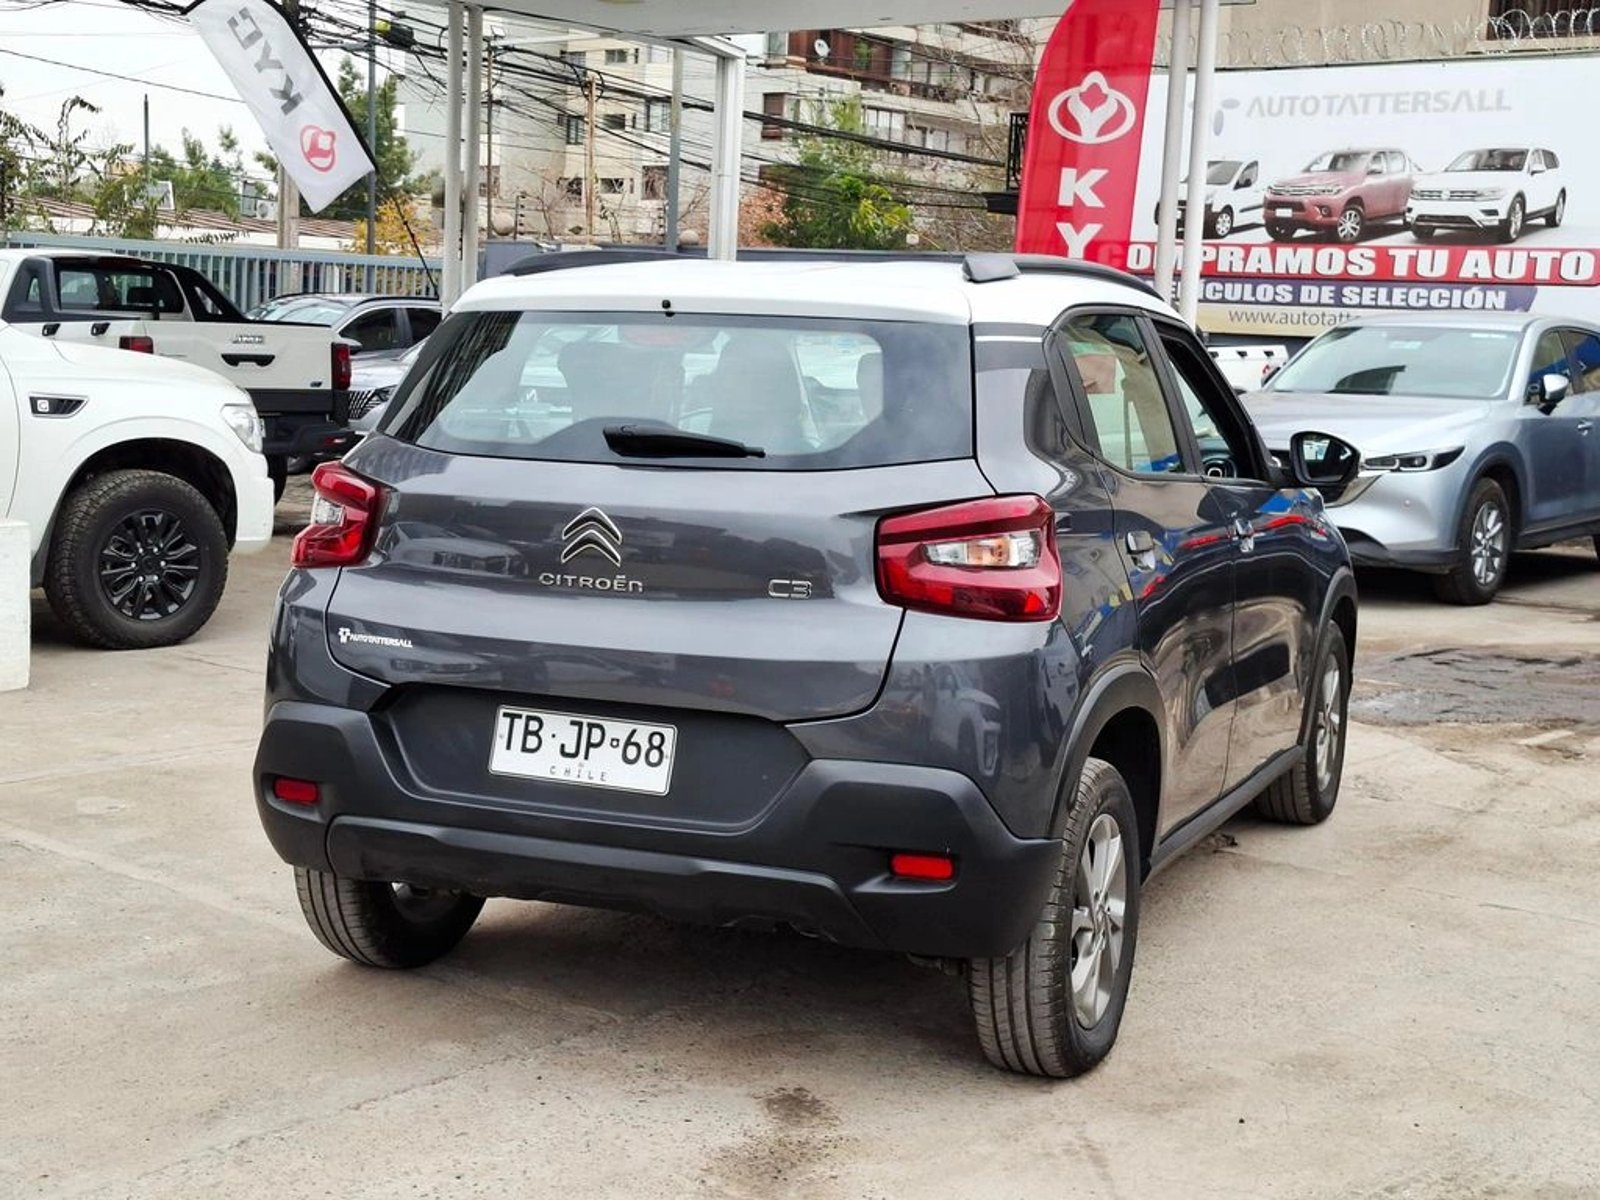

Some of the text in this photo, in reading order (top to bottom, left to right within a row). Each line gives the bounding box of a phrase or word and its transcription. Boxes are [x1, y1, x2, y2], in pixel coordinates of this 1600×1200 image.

[1245, 88, 1512, 119] AUTOTATTERSALL
[1388, 249, 1449, 278] TU
[1458, 249, 1596, 282] AUTO
[1300, 284, 1336, 305] DE
[1341, 285, 1507, 311] SELECCIÓN
[1228, 309, 1361, 328] www.autotatt
[768, 578, 813, 598] C3
[550, 765, 608, 782] CHILE
